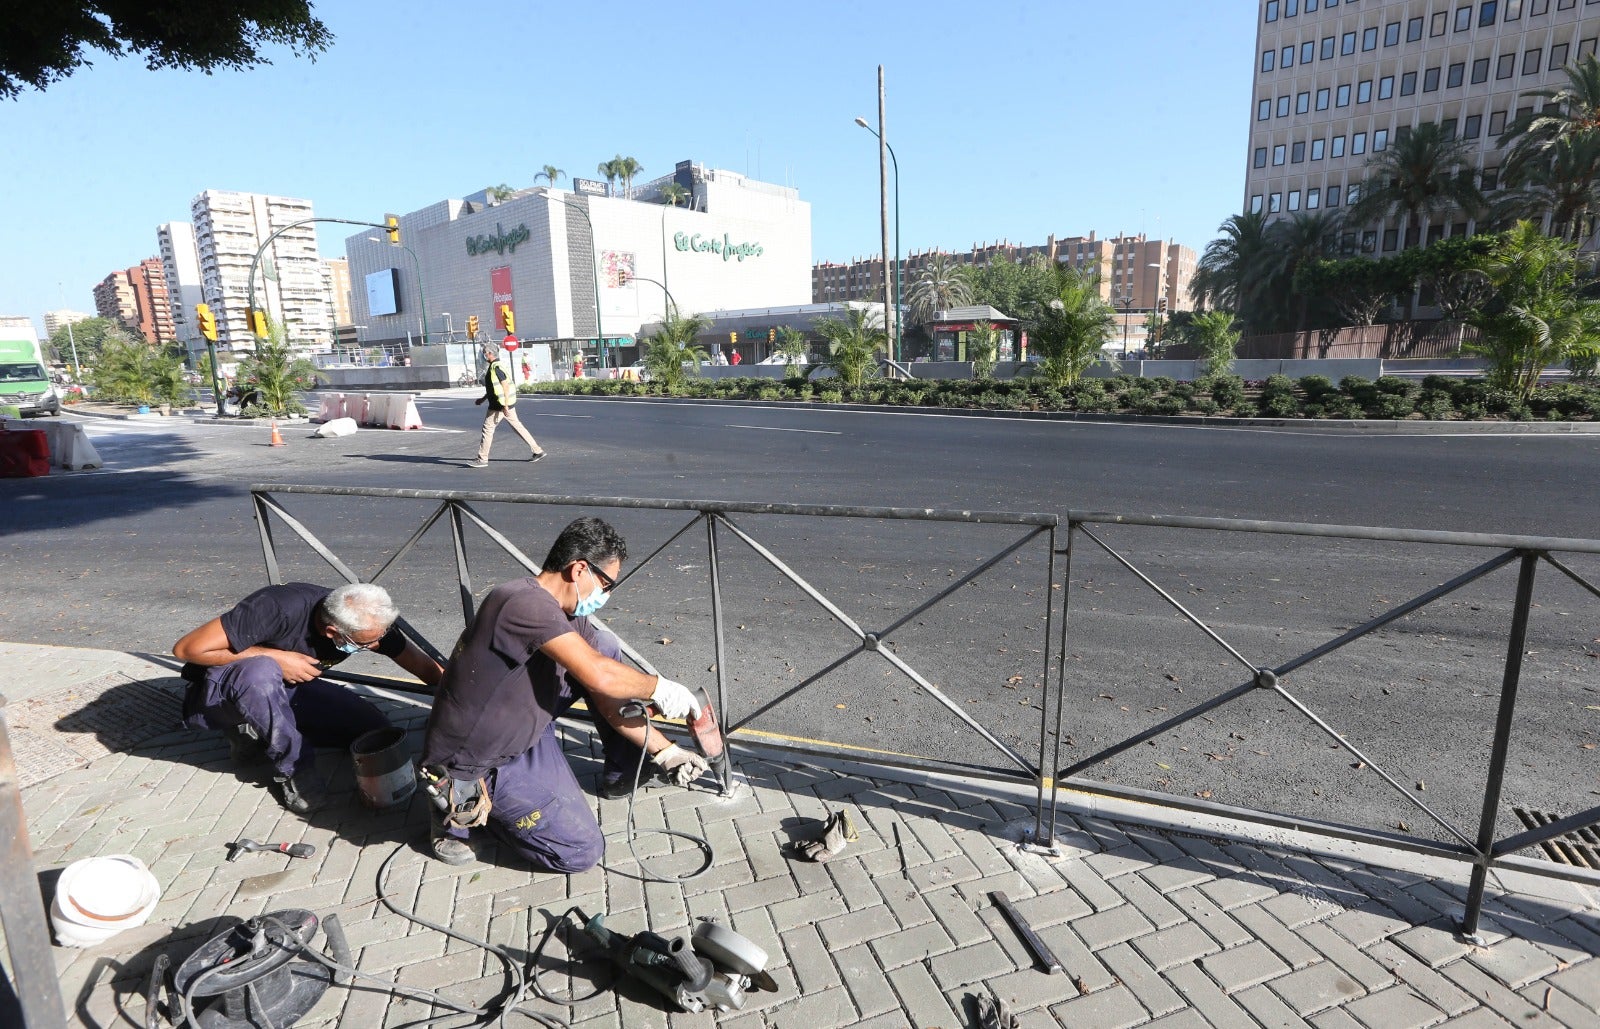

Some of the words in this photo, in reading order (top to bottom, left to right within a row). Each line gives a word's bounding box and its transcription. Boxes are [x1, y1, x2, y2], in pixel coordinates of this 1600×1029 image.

[466, 236, 477, 256] El
[476, 234, 498, 253] Corte
[674, 231, 690, 252] El
[690, 233, 722, 254] Corte
[722, 232, 764, 262] Inglés
